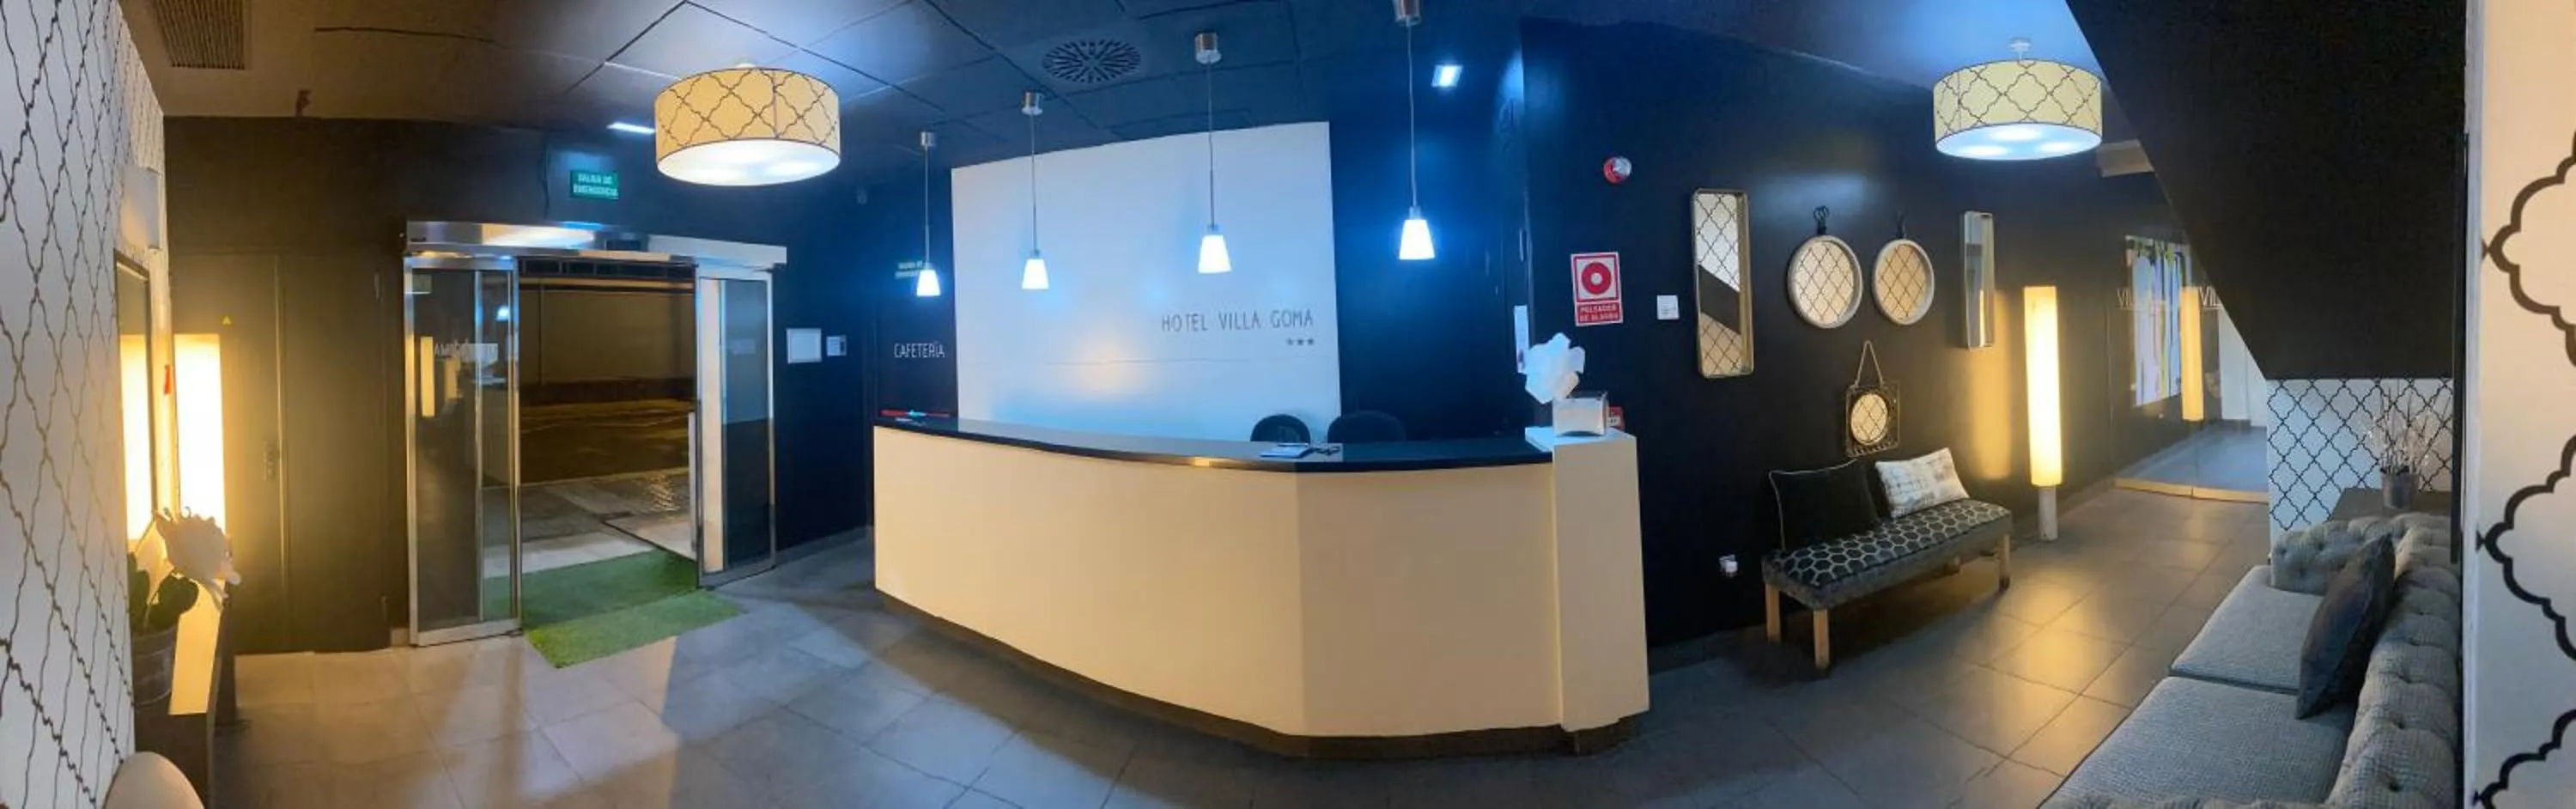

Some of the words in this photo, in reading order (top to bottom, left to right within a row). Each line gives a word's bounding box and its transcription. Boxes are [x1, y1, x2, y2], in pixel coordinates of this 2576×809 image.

[1161, 313, 1208, 332] HOTEL
[1218, 310, 1262, 331] VILLA
[1271, 308, 1314, 329] GOMA
[894, 340, 945, 358] CAFETERÍA
